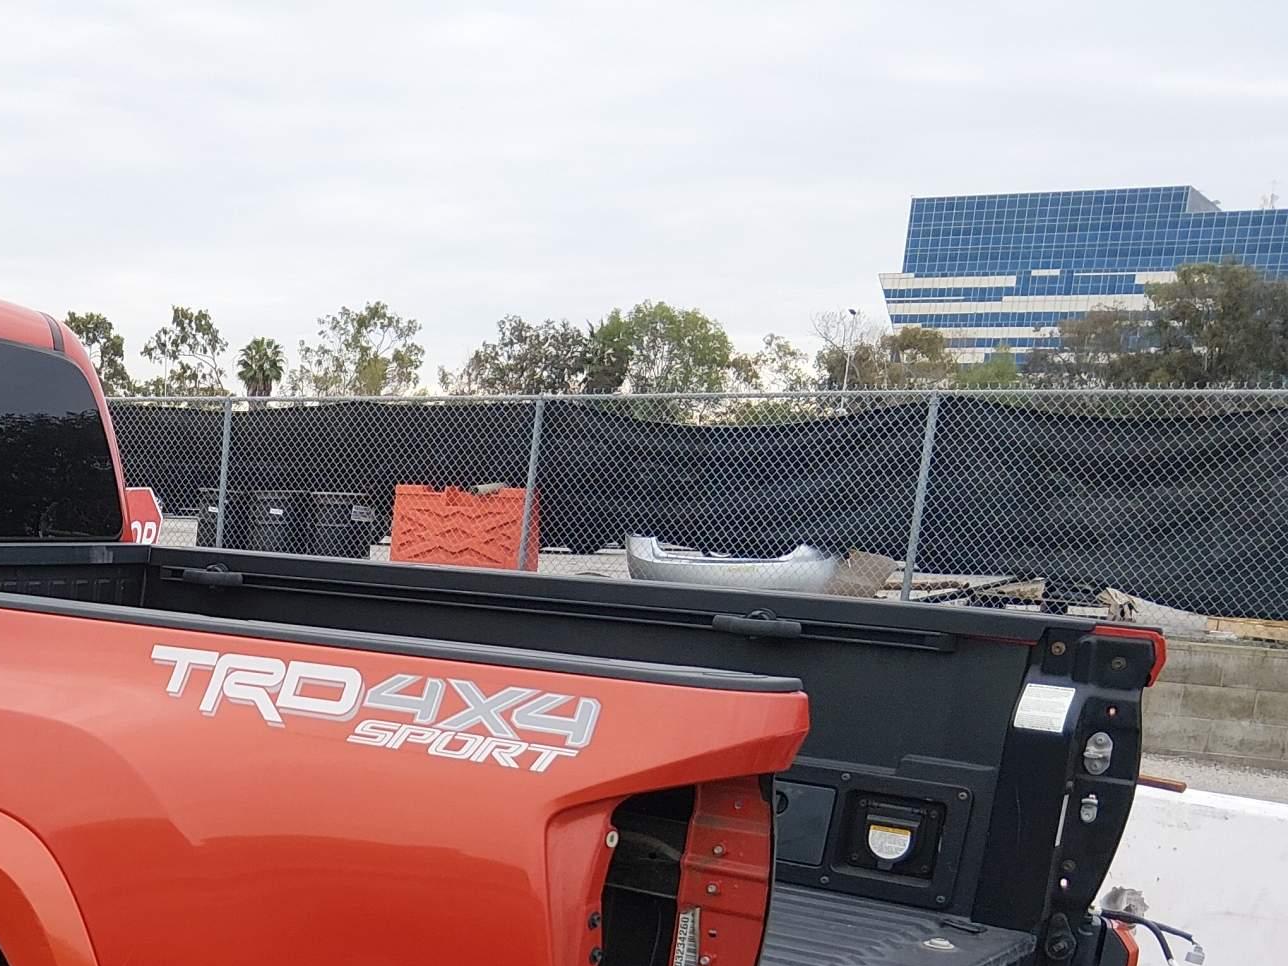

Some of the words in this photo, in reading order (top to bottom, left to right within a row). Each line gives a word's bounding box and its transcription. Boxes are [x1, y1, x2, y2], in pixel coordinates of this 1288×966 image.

[130, 520, 157, 544] OP
[151, 644, 365, 729] TRD
[362, 673, 602, 749] 4X4
[346, 719, 580, 773] SPORT
